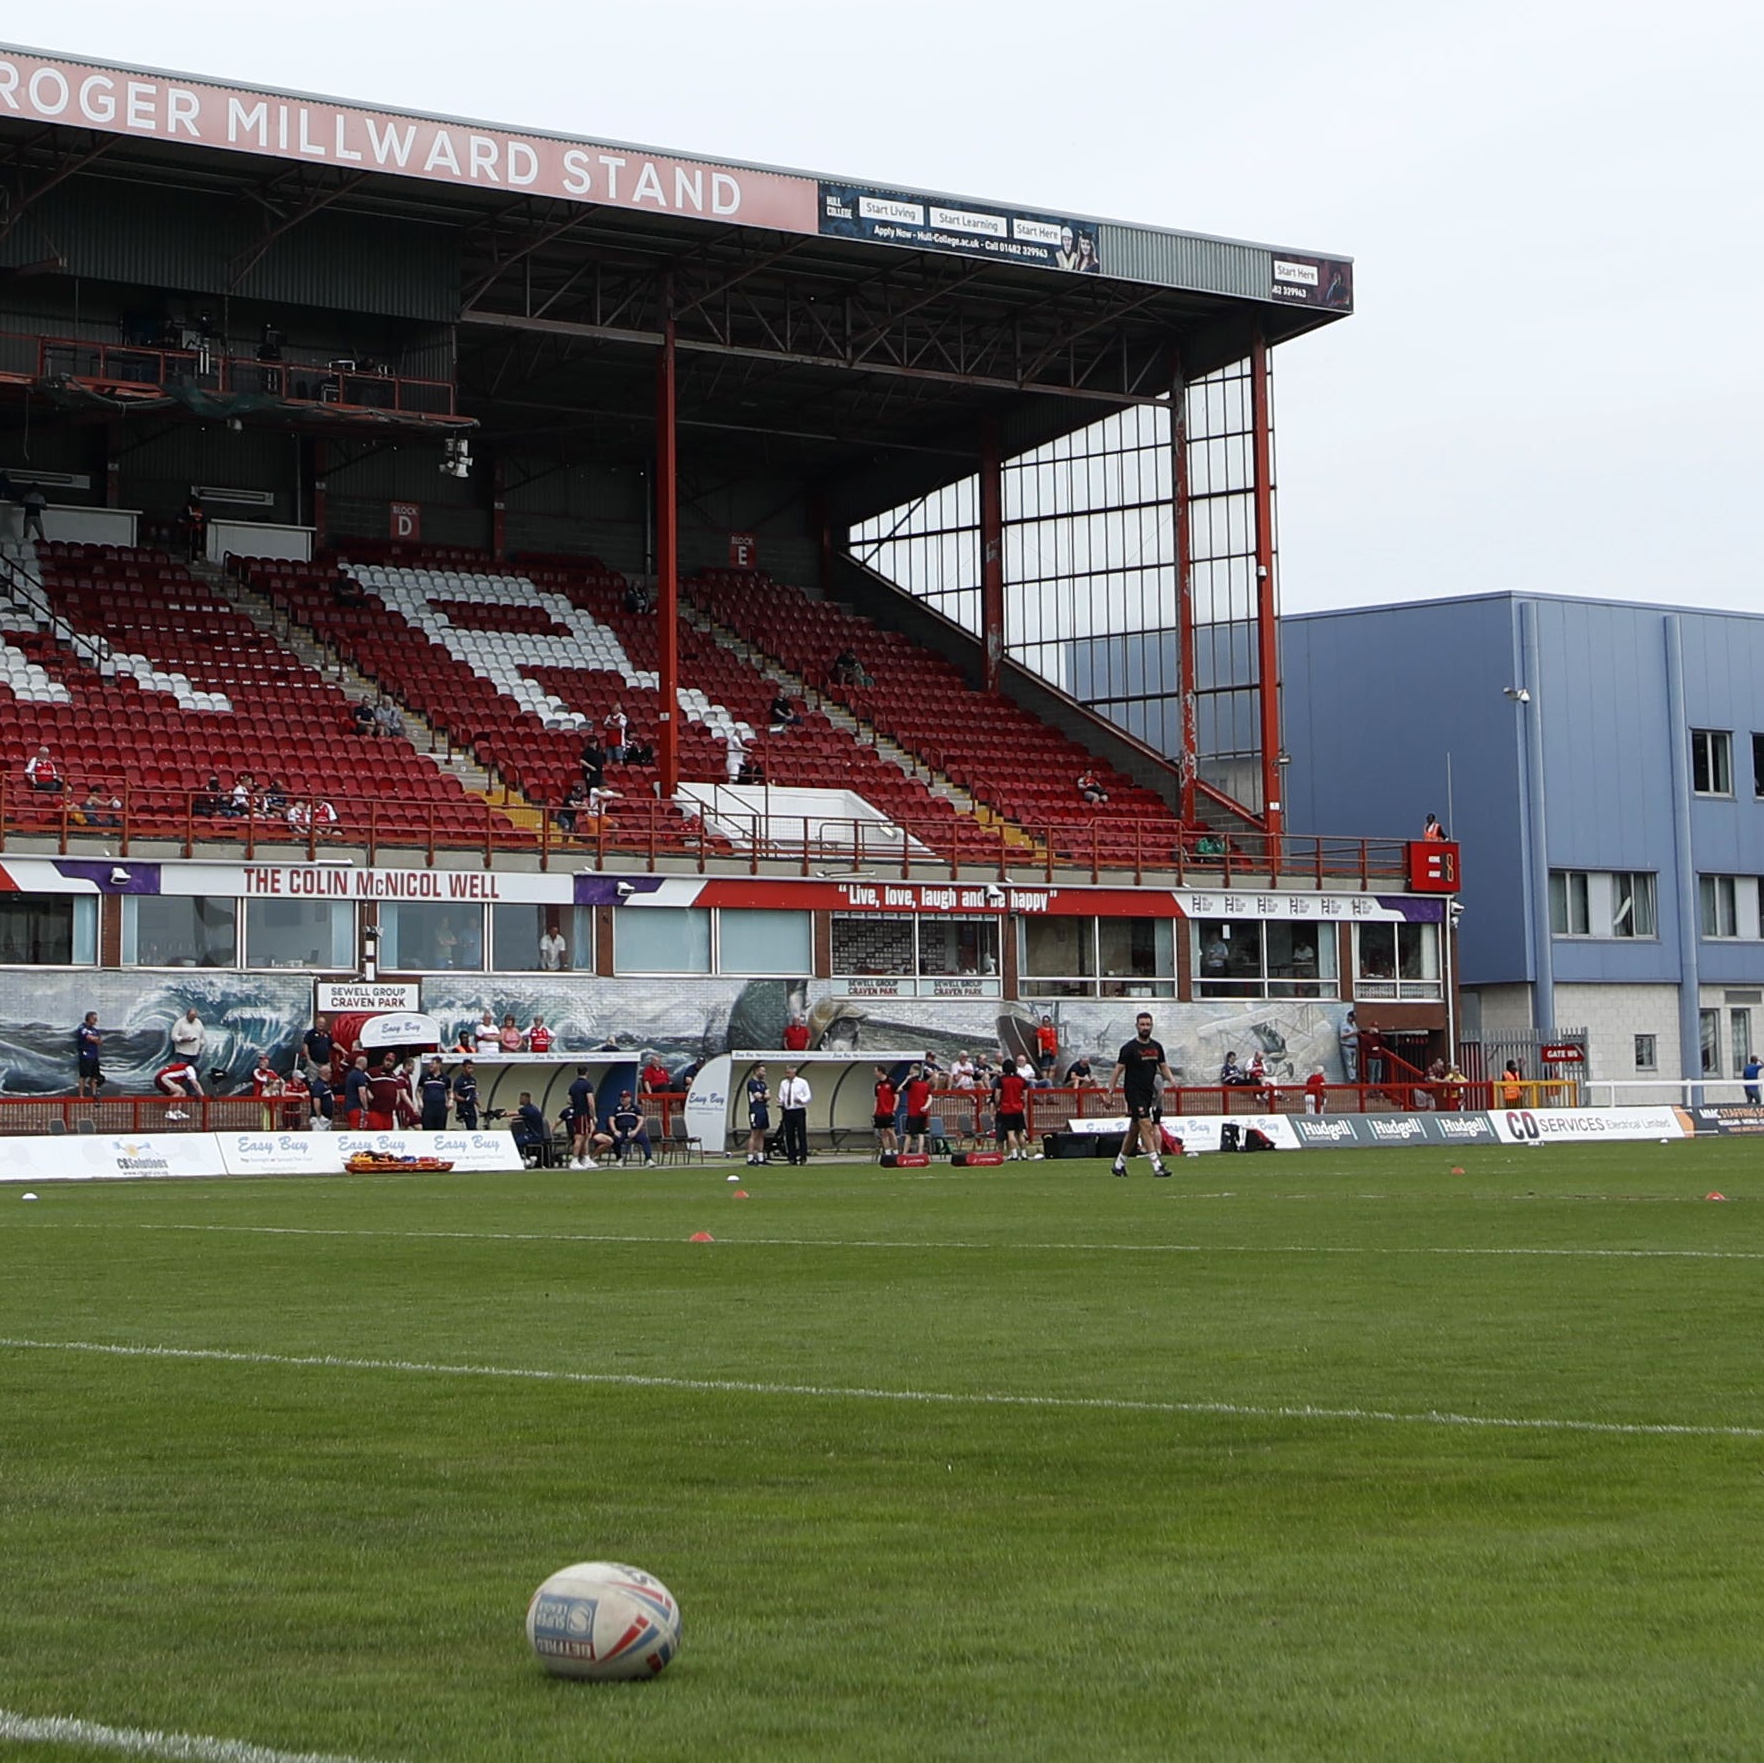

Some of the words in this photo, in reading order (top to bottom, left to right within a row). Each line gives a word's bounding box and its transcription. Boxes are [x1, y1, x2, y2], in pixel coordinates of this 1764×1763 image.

[227, 97, 539, 186] MILLWARD
[562, 149, 741, 216] STAND
[866, 202, 888, 215] Start
[890, 206, 916, 222] Living
[939, 212, 960, 226] Start
[962, 216, 999, 233] Learning
[1016, 223, 1036, 236] Start
[1038, 227, 1059, 240] Here
[393, 505, 419, 516] BLOCK
[398, 515, 413, 536] D
[738, 545, 749, 566] E
[243, 868, 282, 893] THE
[289, 869, 348, 895] COLIN
[355, 871, 442, 897] McNICOL
[448, 873, 500, 898] WELL
[885, 885, 917, 909] love,
[921, 886, 957, 910] laugh
[961, 888, 985, 908] and
[331, 987, 369, 997] SEWELL
[373, 988, 406, 997] GROUP
[848, 987, 878, 996] CRAVEN
[879, 988, 899, 996] PARK
[933, 987, 963, 996] CRAVEN
[964, 988, 983, 996] PARK
[330, 998, 374, 1008] CRAVEN
[378, 998, 406, 1008] PARK
[381, 1022, 401, 1036] Easy
[403, 1021, 423, 1035] Buy
[688, 1091, 708, 1106] Easy
[709, 1092, 726, 1107] Buy
[1187, 1120, 1210, 1135] Buy
[1303, 1120, 1351, 1141] Hudgell
[1372, 1118, 1421, 1139] Hudgell
[1440, 1116, 1488, 1138] Hudgell
[1505, 1111, 1538, 1140] CD
[1539, 1116, 1605, 1133] SERVICES
[237, 1136, 275, 1153] Easy
[278, 1136, 309, 1153] Buy
[338, 1136, 375, 1153] Easy
[376, 1136, 407, 1153] Buy
[433, 1135, 470, 1152] Easy
[471, 1135, 501, 1151] Buy
